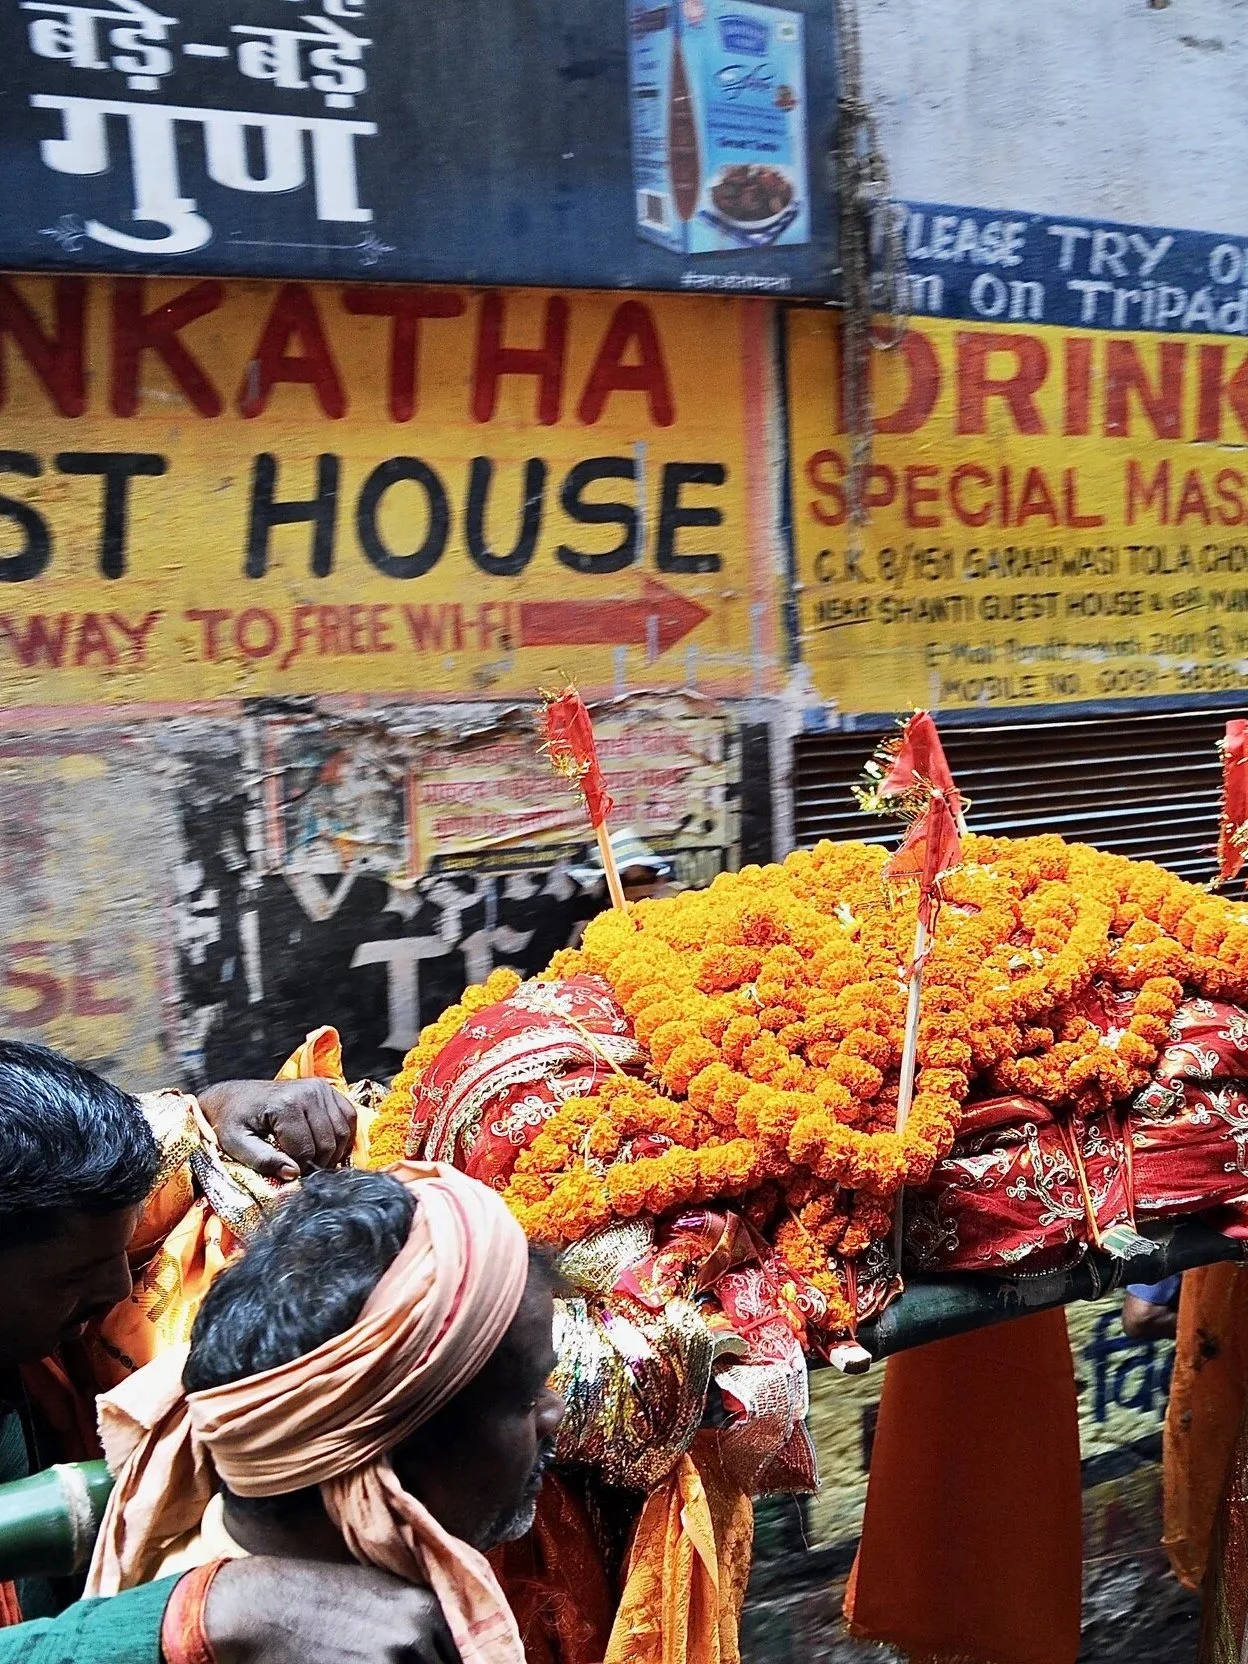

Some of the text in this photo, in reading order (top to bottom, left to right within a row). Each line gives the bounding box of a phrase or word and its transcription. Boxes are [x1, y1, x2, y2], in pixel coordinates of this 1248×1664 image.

[28, 93, 378, 254] गुण
[1048, 223, 1176, 278] TRY
[0, 272, 677, 427] NKATHA
[244, 451, 728, 580] HOUSE
[804, 449, 1107, 529] SPECIAL
[878, 595, 974, 625] SHANTI
[978, 591, 1061, 622] GUEST
[1065, 590, 1144, 616] HOUSE
